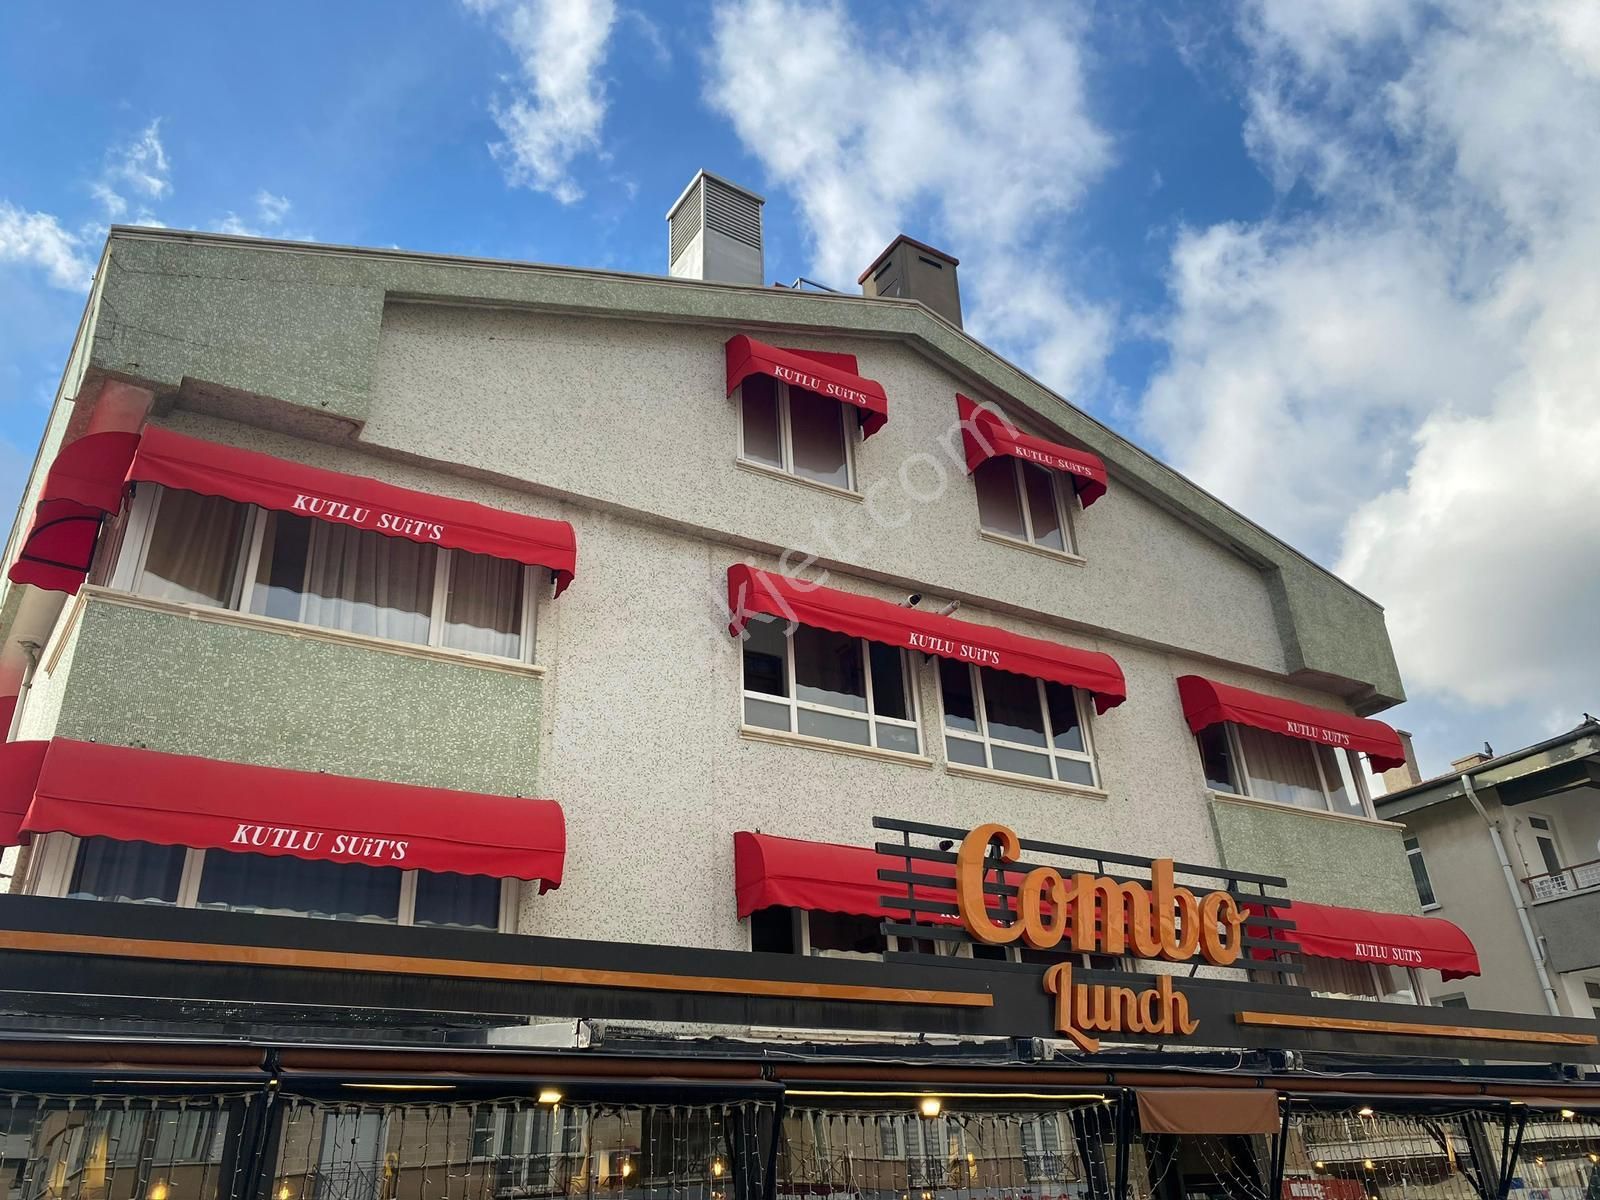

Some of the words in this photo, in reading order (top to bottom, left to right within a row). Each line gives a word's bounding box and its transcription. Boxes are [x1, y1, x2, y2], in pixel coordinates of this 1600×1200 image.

[774, 365, 820, 389] KUTLU
[1015, 446, 1053, 464] KUTLU
[291, 494, 371, 523] KUTLU
[908, 632, 955, 654] KUTLU
[1287, 721, 1318, 738] KUTLU
[231, 823, 325, 851] KUTLU
[957, 823, 1250, 966] Combo
[1355, 943, 1388, 959] KUTLU
[1043, 961, 1201, 1054] Lunch
